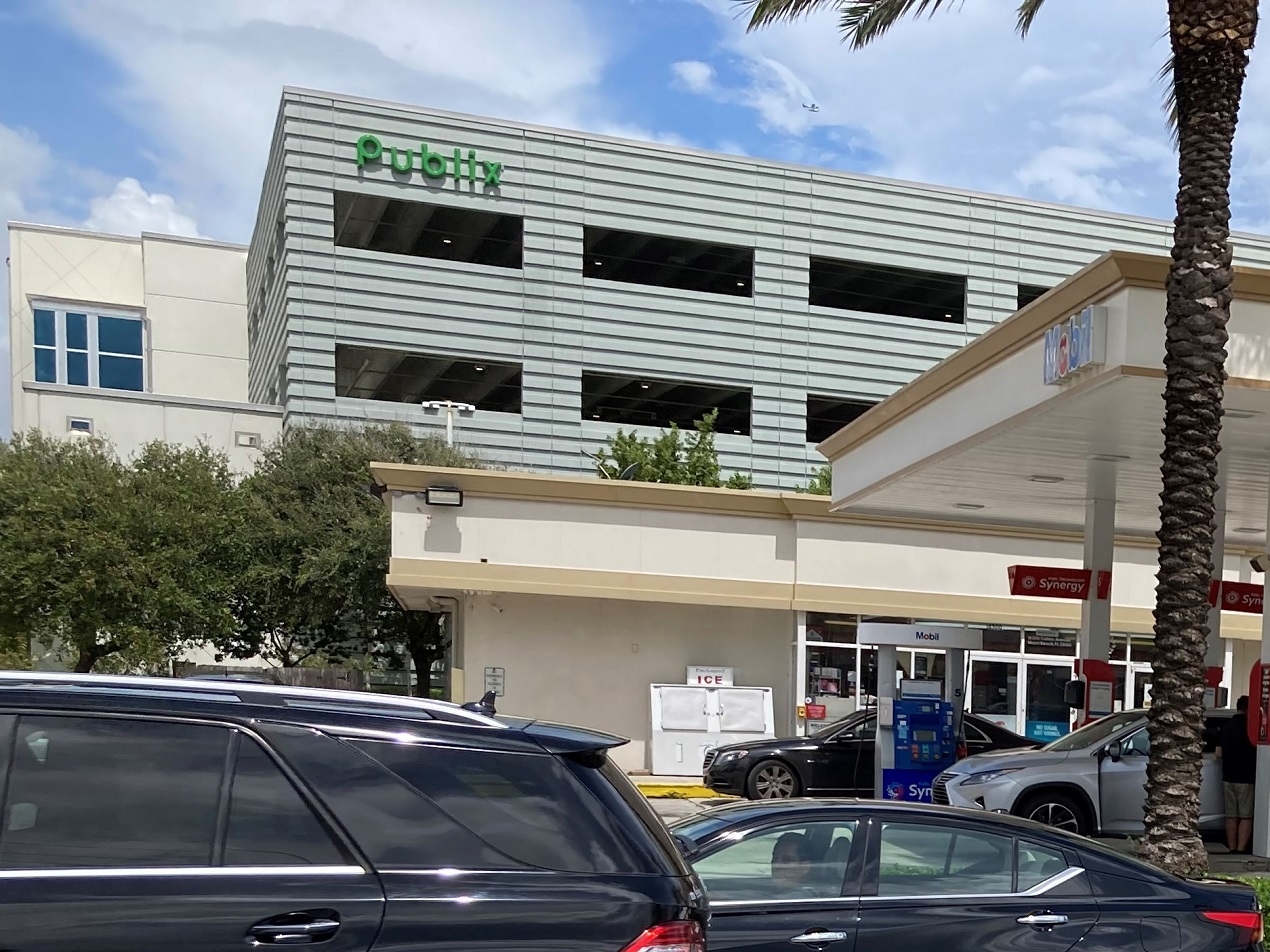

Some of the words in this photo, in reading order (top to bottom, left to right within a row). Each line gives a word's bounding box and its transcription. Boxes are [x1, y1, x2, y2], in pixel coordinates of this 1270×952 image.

[356, 134, 502, 186] Publix
[1039, 578, 1085, 593] Synergy
[1242, 594, 1263, 606] Syn
[915, 631, 940, 641] Mobil
[697, 675, 723, 684] ICE
[954, 688, 962, 697] 5
[909, 784, 932, 799] Syn
